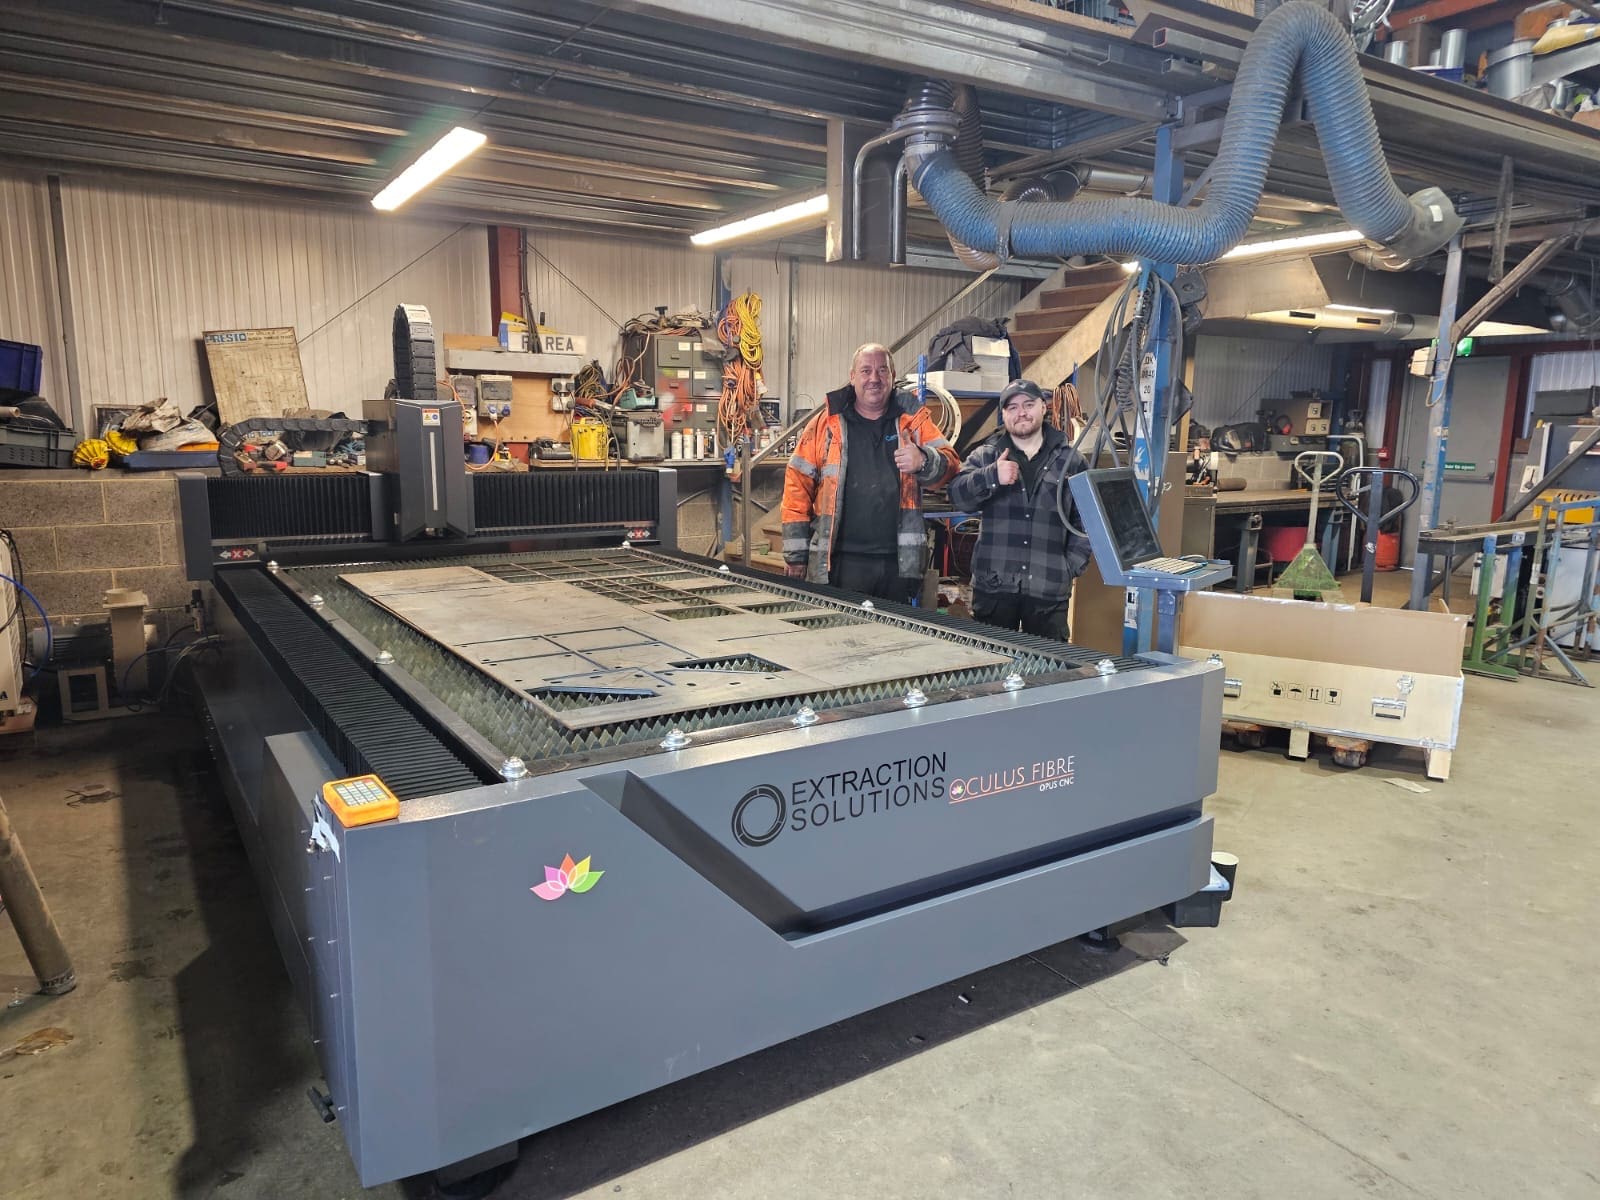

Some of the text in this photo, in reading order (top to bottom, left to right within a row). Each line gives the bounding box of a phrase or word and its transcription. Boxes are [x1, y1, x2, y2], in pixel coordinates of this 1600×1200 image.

[545, 336, 575, 352] REA
[791, 751, 947, 806] EXTRACTION
[948, 755, 1076, 801] OCULUS FIBRE
[1039, 776, 1075, 792] OPUS CNC
[790, 776, 946, 833] SOLUTIONS
